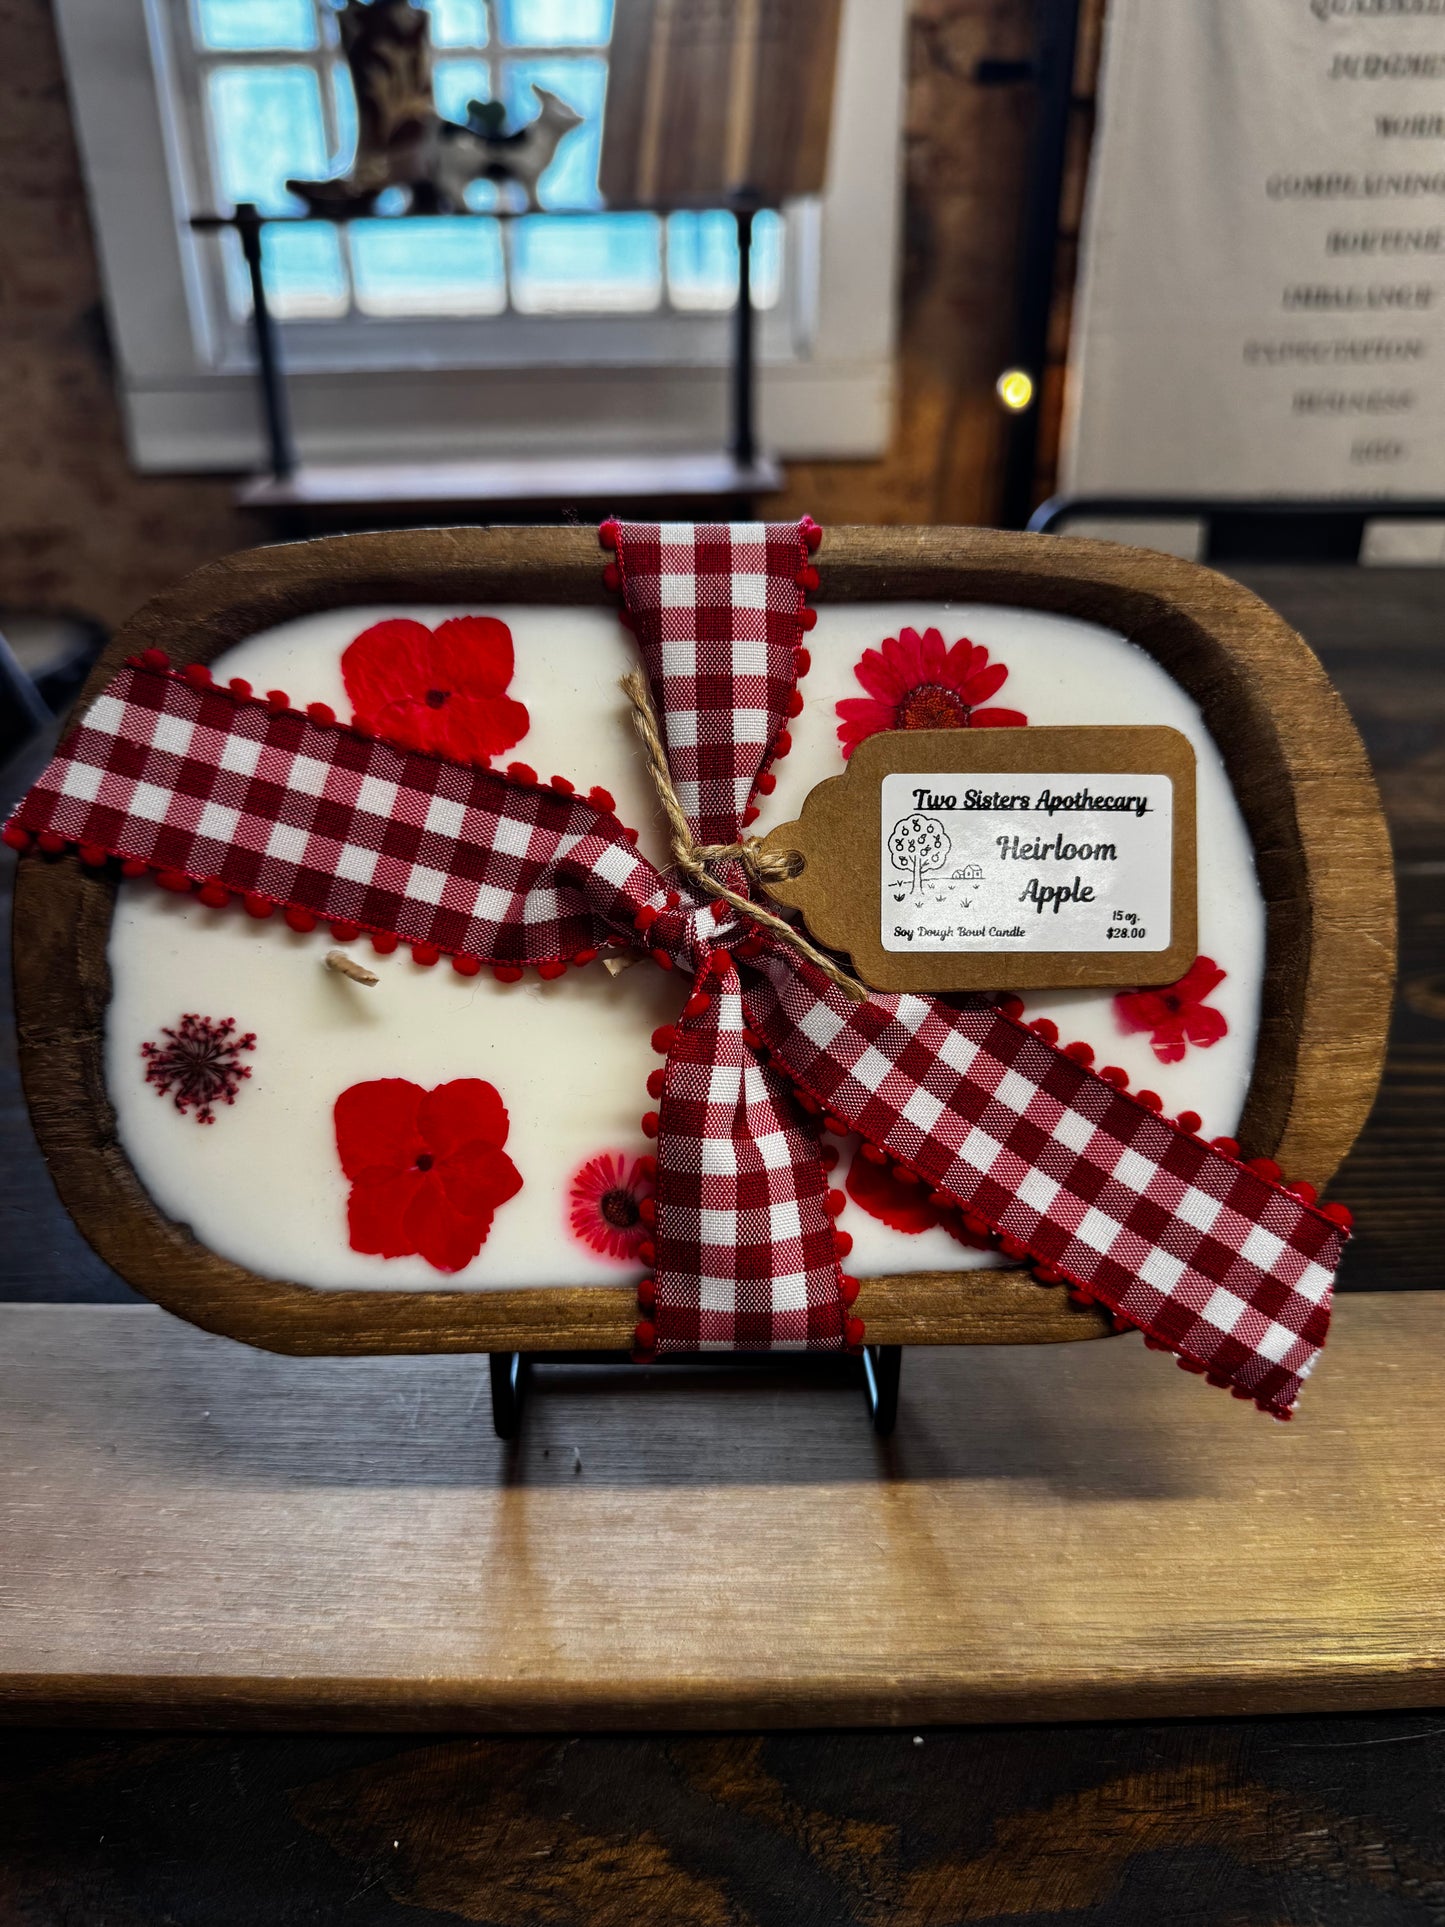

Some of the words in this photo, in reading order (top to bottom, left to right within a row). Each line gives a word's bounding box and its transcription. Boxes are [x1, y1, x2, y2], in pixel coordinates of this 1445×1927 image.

[912, 788, 957, 810] Two
[963, 788, 1031, 810] Sisters
[1035, 788, 1148, 817] Apothecary
[996, 833, 1118, 861] Heirloom
[1018, 876, 1096, 914] Apple
[1112, 910, 1124, 921] 15
[893, 926, 914, 941] Soy
[917, 926, 954, 941] Dough
[957, 926, 986, 938] Bowl
[988, 926, 1026, 938] Candle
[1106, 927, 1146, 940] $28.00
